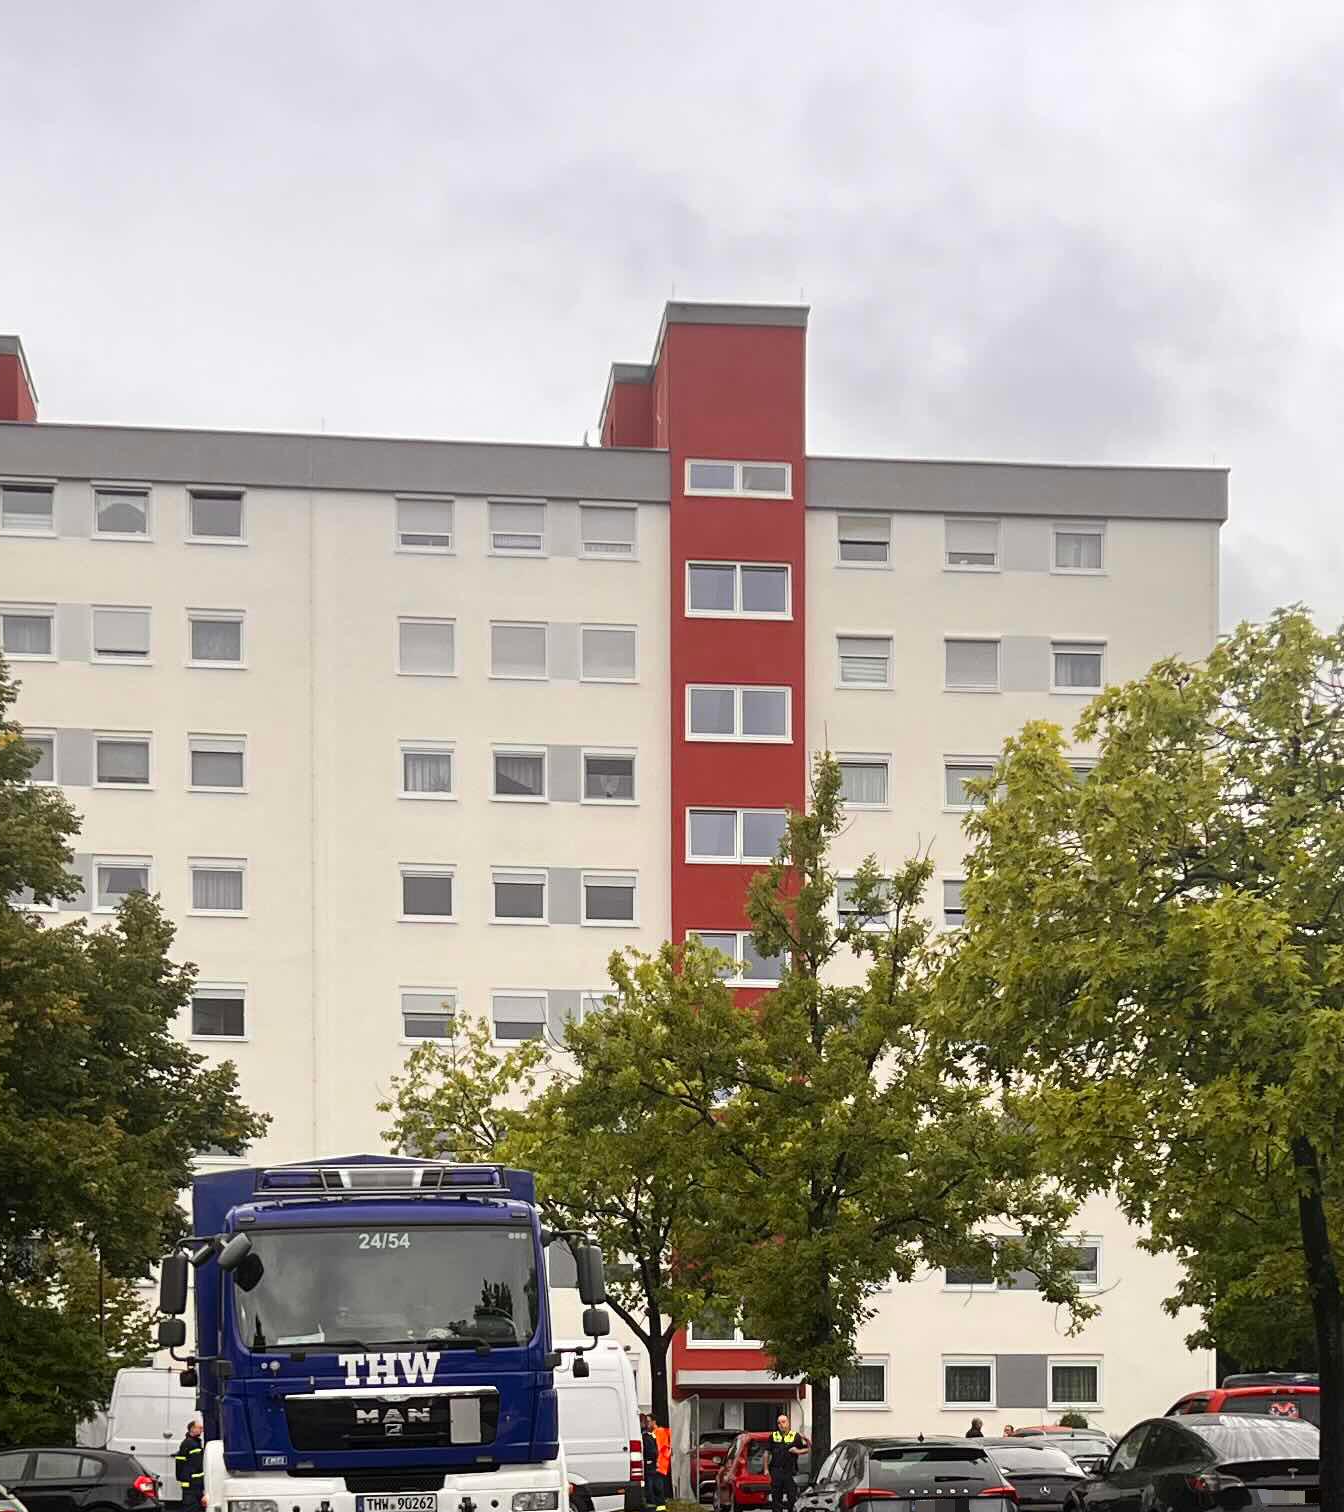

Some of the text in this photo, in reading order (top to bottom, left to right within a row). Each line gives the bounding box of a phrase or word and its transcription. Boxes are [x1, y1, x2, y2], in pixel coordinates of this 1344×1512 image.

[359, 1233, 410, 1249] 24/54
[338, 1352, 440, 1385] THW
[356, 1408, 431, 1424] MAN
[397, 1496, 434, 1510] 90262
